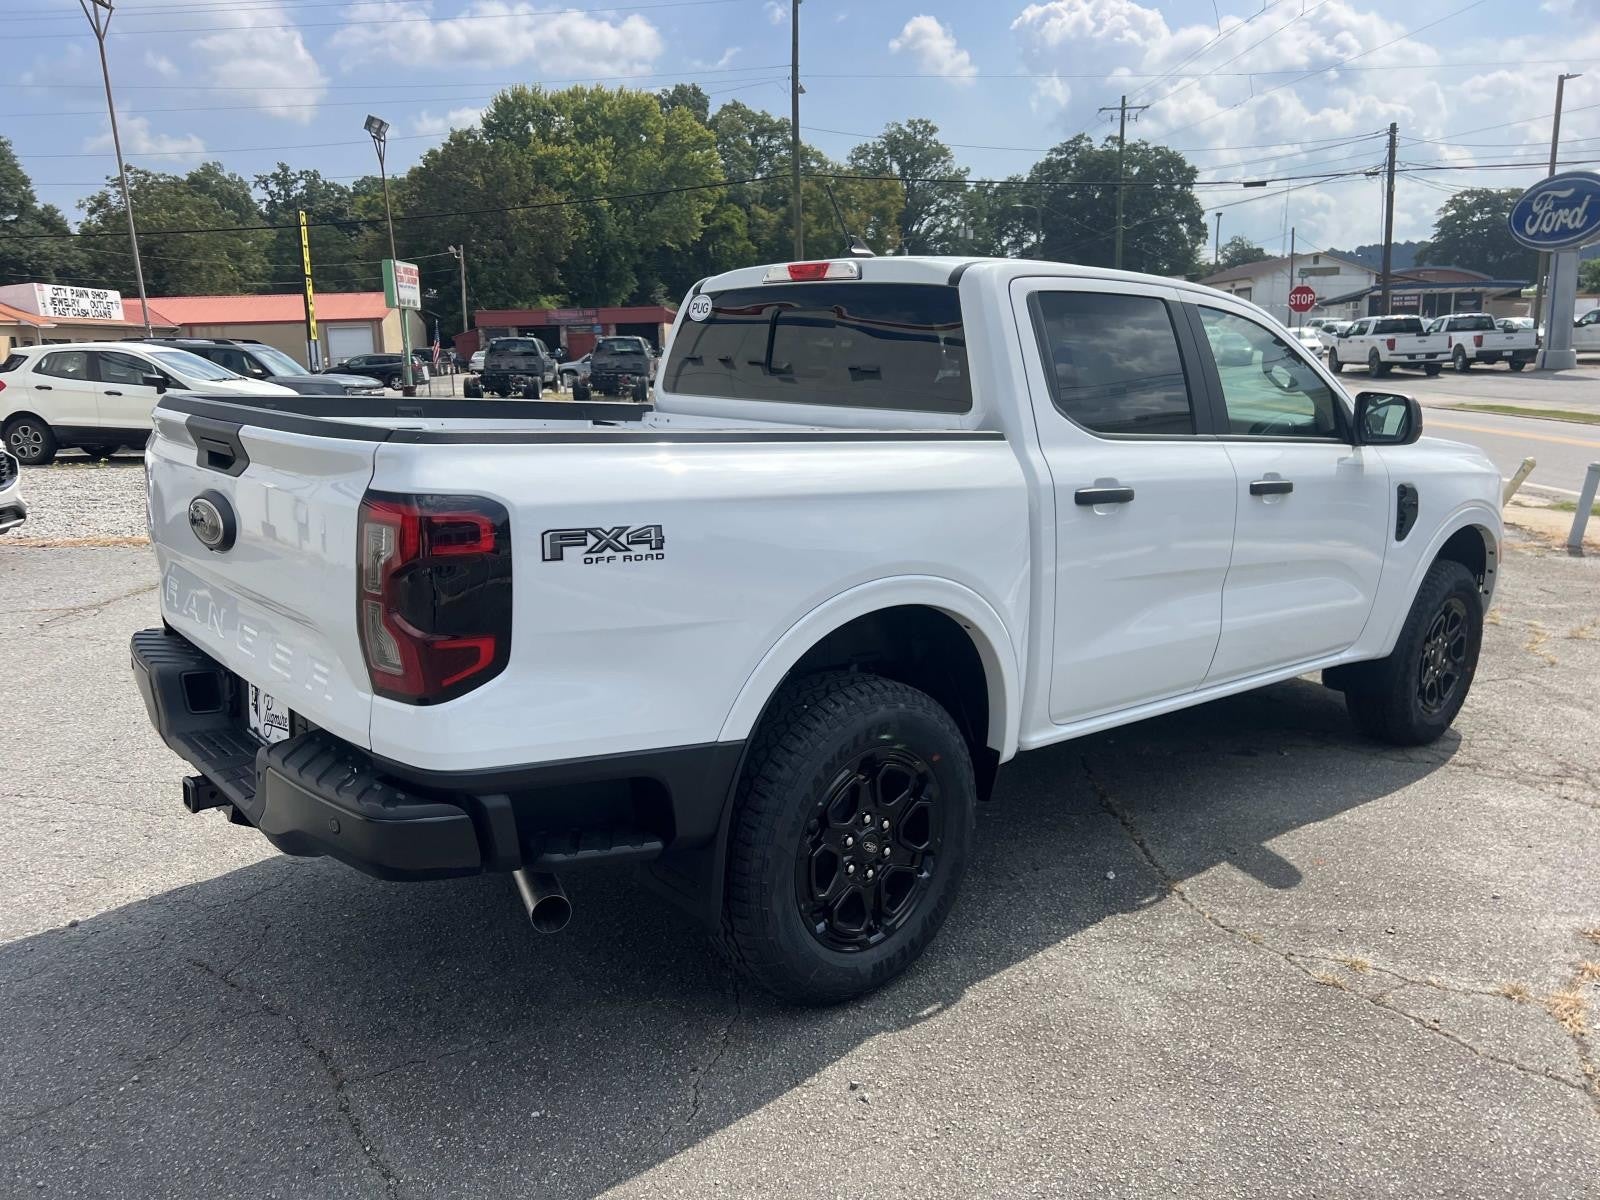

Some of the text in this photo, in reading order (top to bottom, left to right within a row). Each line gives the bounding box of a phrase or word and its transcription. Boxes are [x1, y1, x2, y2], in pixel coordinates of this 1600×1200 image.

[1525, 187, 1592, 236] Ford
[52, 287, 108, 300] CITY PAWN SHOP
[1290, 293, 1315, 305] STOP
[49, 297, 114, 310] JEWELRY OUTLET
[692, 302, 709, 314] PUG
[53, 307, 112, 319] FAST CASH LOANS
[541, 524, 665, 562] FX4
[583, 553, 665, 565] OFF ROAD
